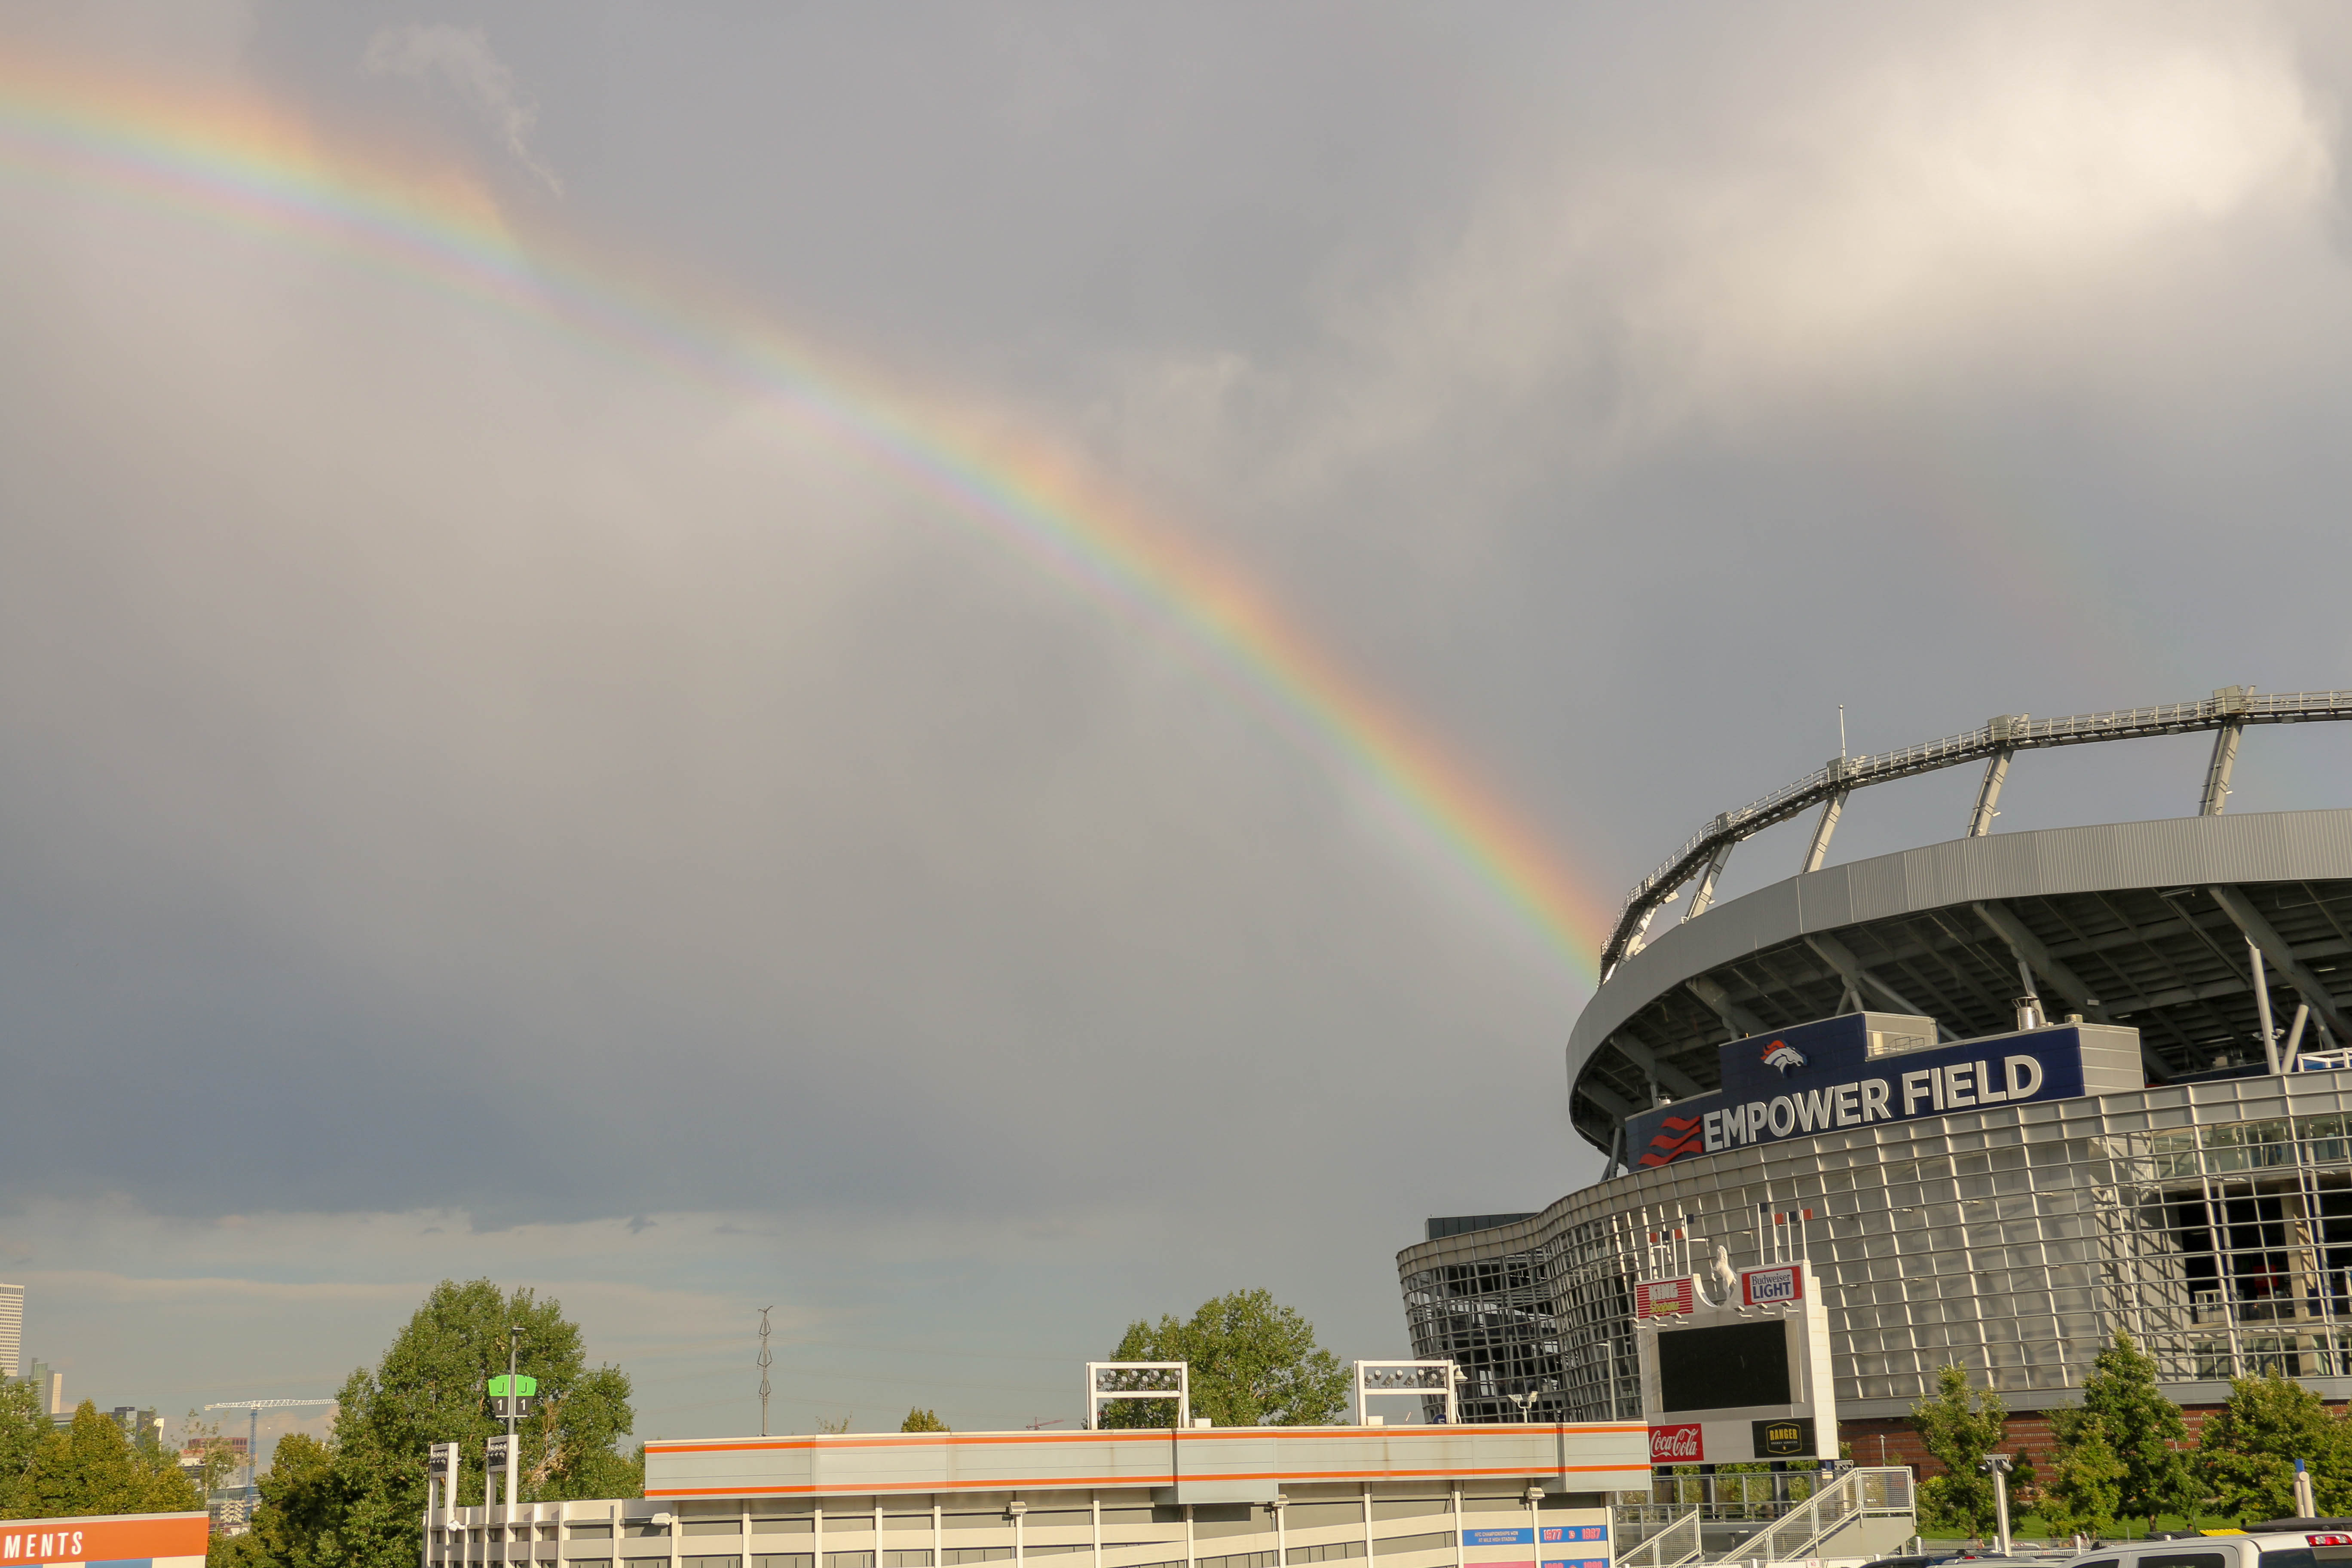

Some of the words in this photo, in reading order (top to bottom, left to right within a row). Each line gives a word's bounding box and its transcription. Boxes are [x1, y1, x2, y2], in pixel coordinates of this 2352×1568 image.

[1703, 1078, 1892, 1152] EMPOWER
[1902, 1054, 2043, 1115] FIELD
[1751, 1273, 1791, 1285] Budweiser
[1648, 1283, 1678, 1301] KING
[1752, 1281, 1791, 1299] LIGHT
[498, 1382, 505, 1393] J
[521, 1382, 527, 1393] J
[497, 1399, 502, 1411] 1
[521, 1399, 526, 1411] 1
[1770, 1428, 1798, 1441] RANGER
[1651, 1428, 1699, 1457] Coca-Cola
[1544, 1528, 1562, 1541] 1977
[1582, 1528, 1601, 1540] 1987
[4, 1531, 83, 1559] MENTS
